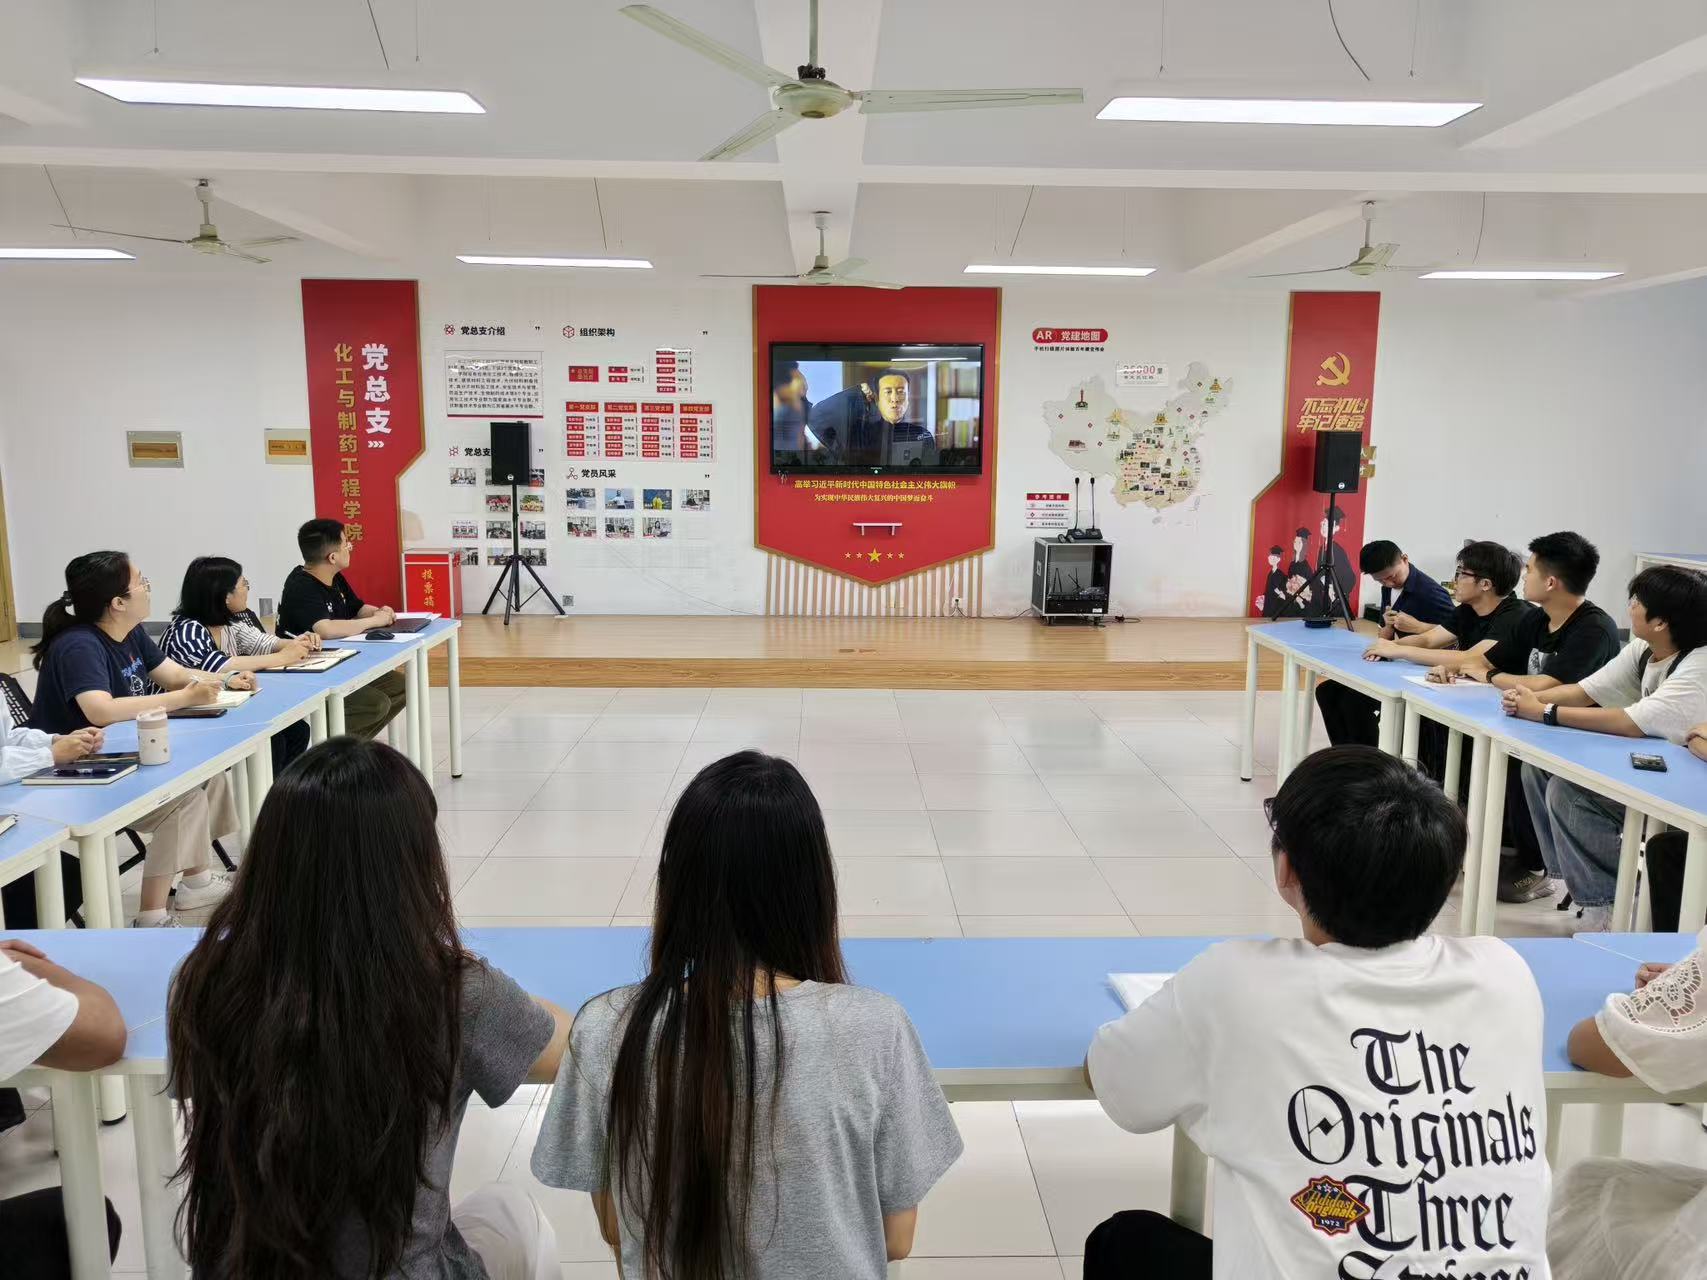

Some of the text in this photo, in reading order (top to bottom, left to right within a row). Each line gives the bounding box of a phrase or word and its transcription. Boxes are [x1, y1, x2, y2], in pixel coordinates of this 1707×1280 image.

[460, 326, 505, 336] 党总支介绍
[579, 327, 616, 337] 组织架构
[1036, 330, 1100, 341] AR 党建地图
[361, 343, 392, 435] 党总支
[1301, 397, 1369, 414] 不忘初心
[1297, 414, 1366, 434] 牢记使命
[334, 343, 364, 542] 化工与制药工程学院
[581, 469, 617, 478] 党员风采
[794, 480, 956, 489] 高举习近平新时代中国特色社会主义伟大旗帜
[814, 494, 934, 503] 为实现中华民族伟大复兴的中国梦而奋斗
[421, 568, 434, 607] 投票箱
[1350, 1028, 1476, 1095] The
[1287, 1085, 1536, 1184] Originals
[1305, 1200, 1358, 1219] Originals
[1343, 1172, 1516, 1252] Three
